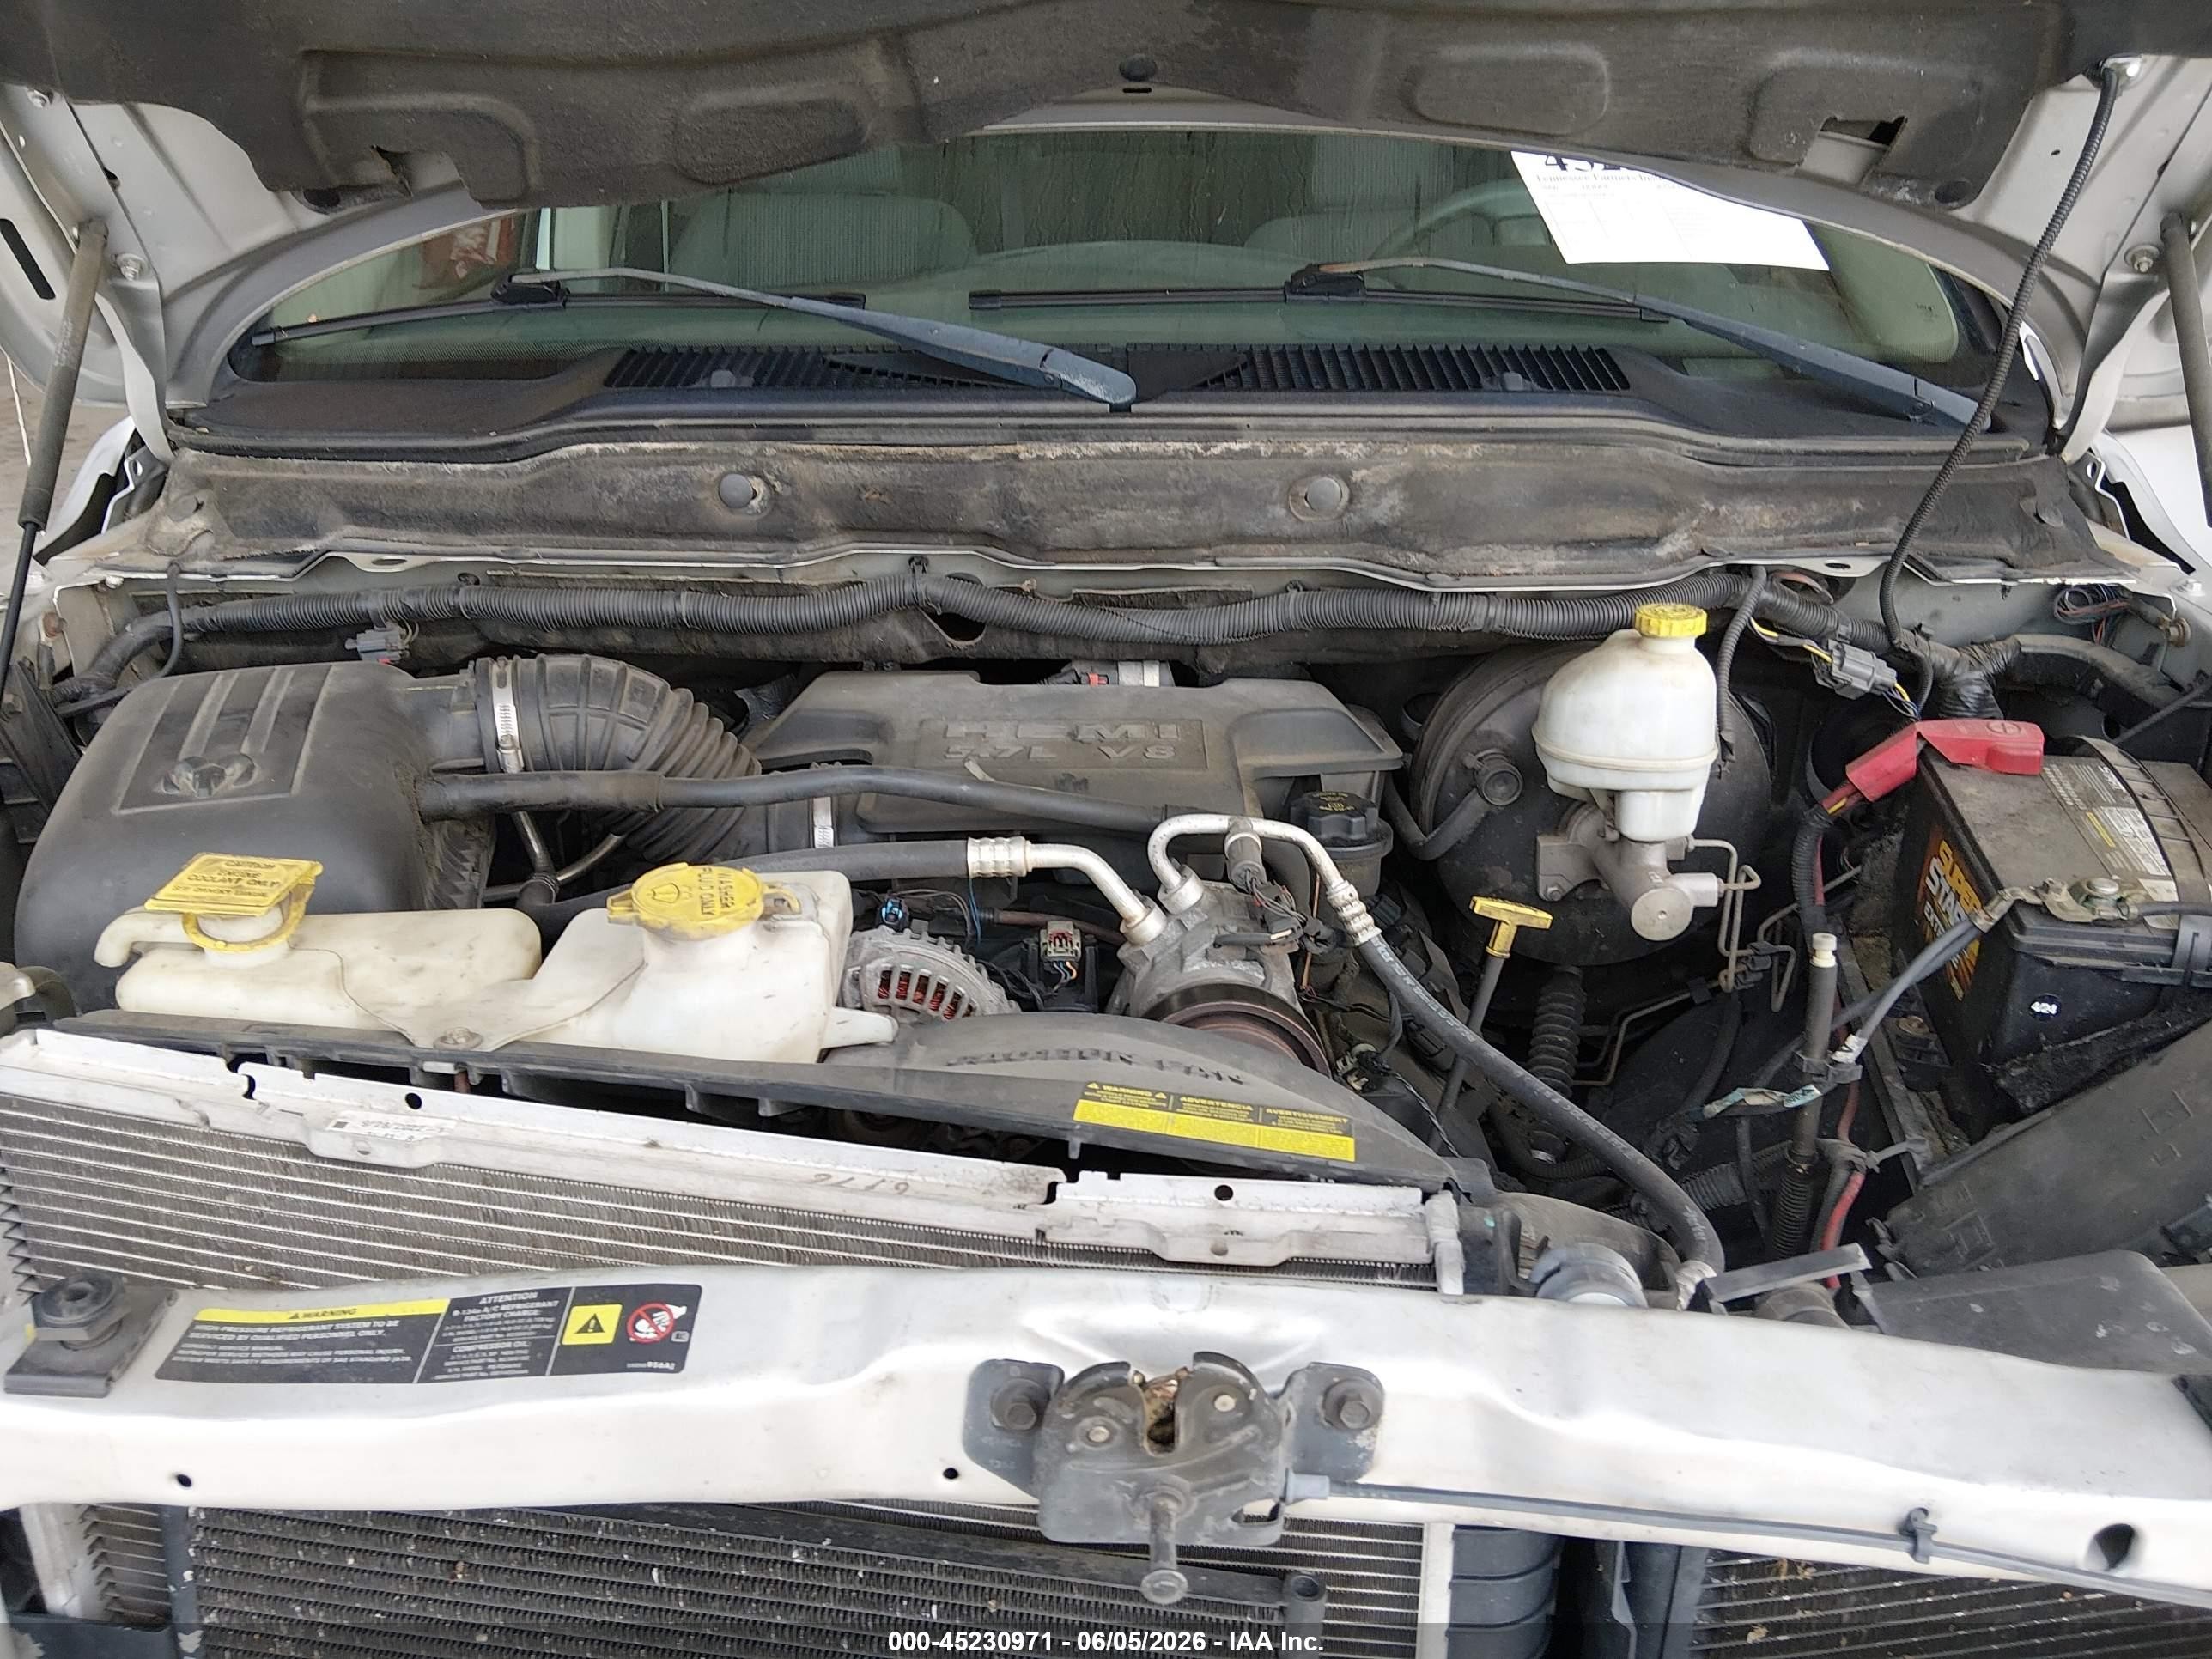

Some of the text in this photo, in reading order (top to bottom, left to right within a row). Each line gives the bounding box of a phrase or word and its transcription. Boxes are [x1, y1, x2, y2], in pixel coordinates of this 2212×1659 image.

[944, 723, 1179, 740] HEMI
[1097, 745, 1176, 759] V8
[187, 873, 242, 884] COOLANT
[1102, 1085, 1152, 1097] WARNING
[1180, 1096, 1254, 1110] ADVERTENCIA
[1266, 1108, 1349, 1124] AVERTISSEMENT
[479, 1291, 538, 1304] ATTENTION
[301, 1308, 357, 1318] WARNING
